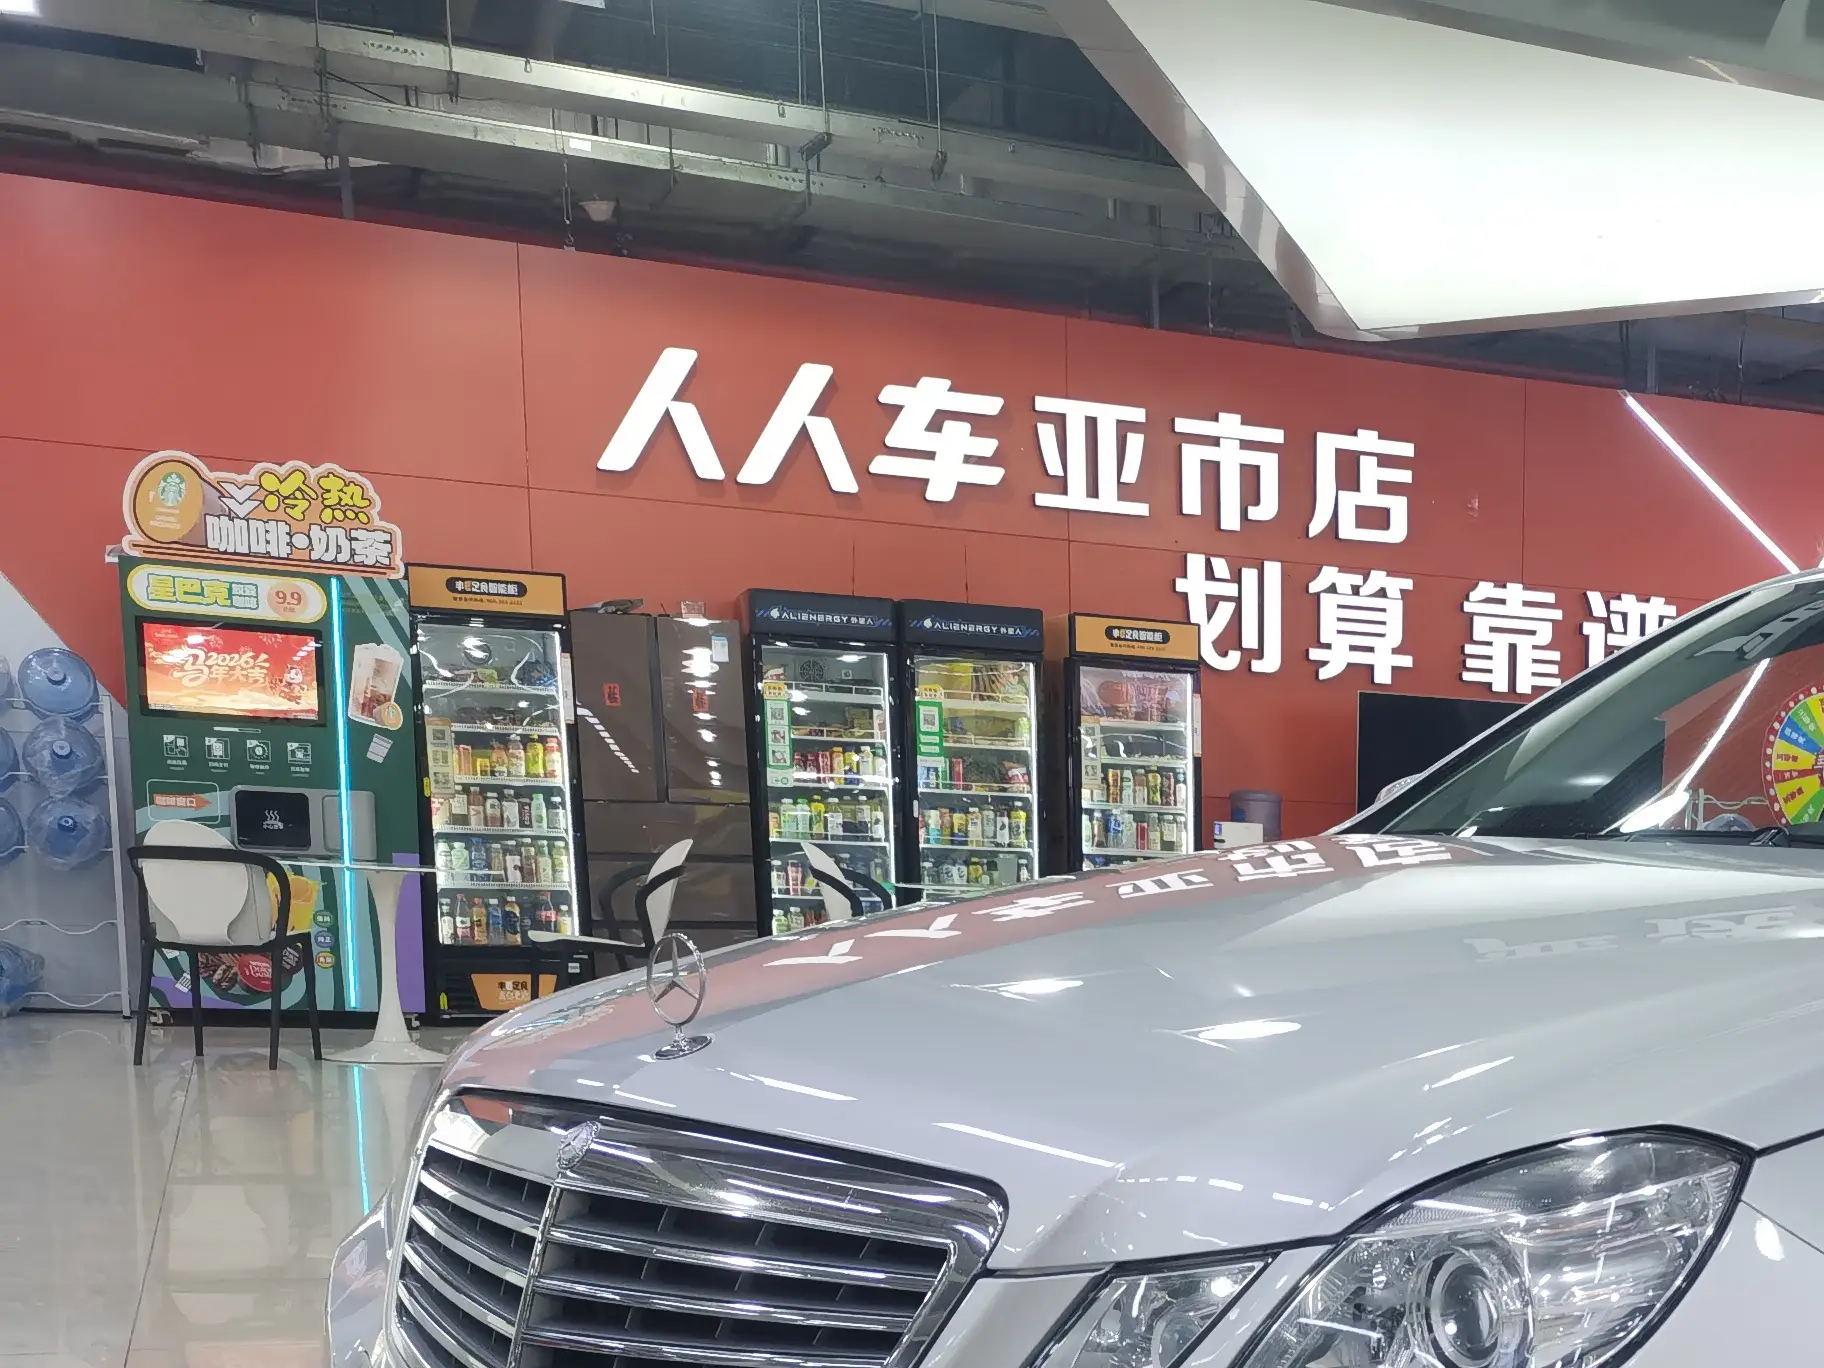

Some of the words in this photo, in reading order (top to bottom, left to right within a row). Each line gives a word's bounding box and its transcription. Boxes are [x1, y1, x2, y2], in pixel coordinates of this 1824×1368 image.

[596, 347, 1415, 543] 人人车亚市店
[259, 469, 371, 524] 冷热
[147, 573, 231, 605] 星巴克
[781, 611, 848, 624] ALIENERGY
[934, 622, 998, 634] ALIENERGY
[1174, 553, 1413, 684] 划算
[206, 651, 255, 667] 2026
